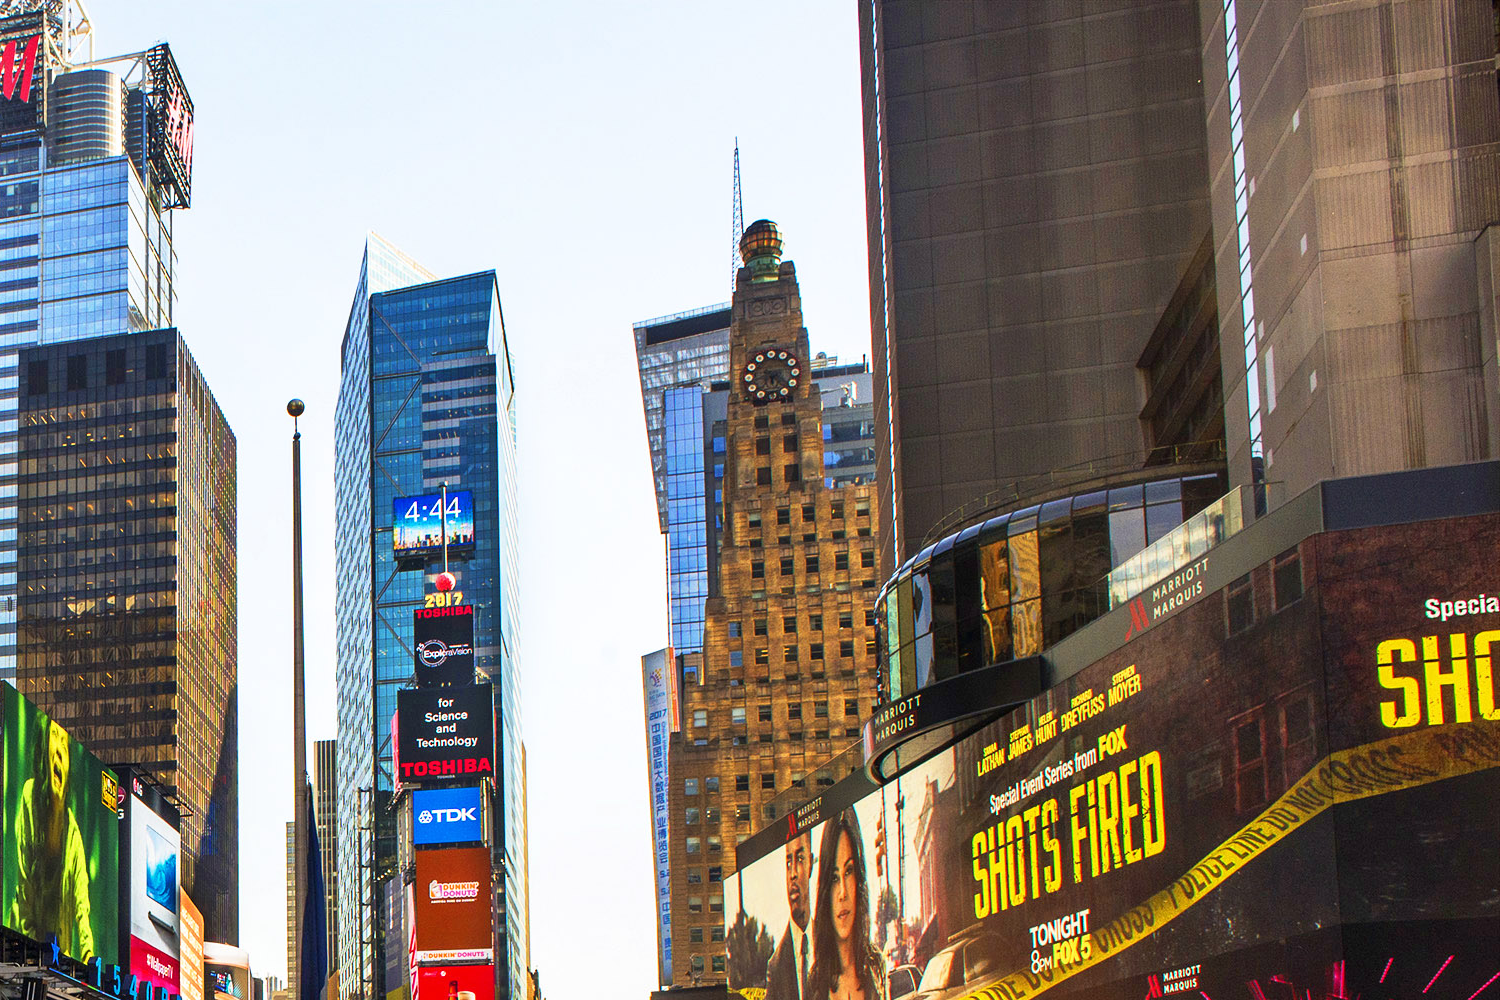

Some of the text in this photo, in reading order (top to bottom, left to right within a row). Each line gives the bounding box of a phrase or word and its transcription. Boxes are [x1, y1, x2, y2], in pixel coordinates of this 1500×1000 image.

[1152, 558, 1209, 601] MARRIOTT
[415, 605, 473, 619] TOSHIBA
[424, 592, 463, 608] 2017
[1153, 581, 1203, 619] MARQUIS
[1425, 594, 1500, 621] Specia
[424, 647, 473, 659] ExploraVision
[437, 698, 453, 708] for
[1108, 673, 1142, 706] MOYER
[425, 711, 468, 722] Science
[874, 694, 922, 729] MARRIOTT
[1061, 693, 1105, 732] DREYFUSS
[436, 723, 457, 733] and
[875, 714, 916, 744] MARQUIS
[1036, 718, 1058, 747] HUNT
[416, 736, 478, 749] Technology
[1007, 733, 1033, 762] JAMES
[1098, 724, 1128, 762] FOX
[401, 757, 492, 777] TOSHIBA
[976, 748, 1005, 777] LATHAN
[990, 748, 1097, 815] Special Event Series from
[431, 807, 477, 823] TDK
[972, 750, 1167, 920] SHOTS FIRED
[443, 882, 479, 891] DUNKIN'
[443, 889, 478, 898] DONUTS
[1030, 908, 1091, 950] TONIGHT
[146, 953, 173, 980] #WallpaperTV
[428, 950, 484, 959] DUNKIN' DONUTS
[1052, 938, 1080, 969] FOX
[1163, 964, 1201, 981] MARRIOTT
[1163, 978, 1198, 994] MARQUIS
